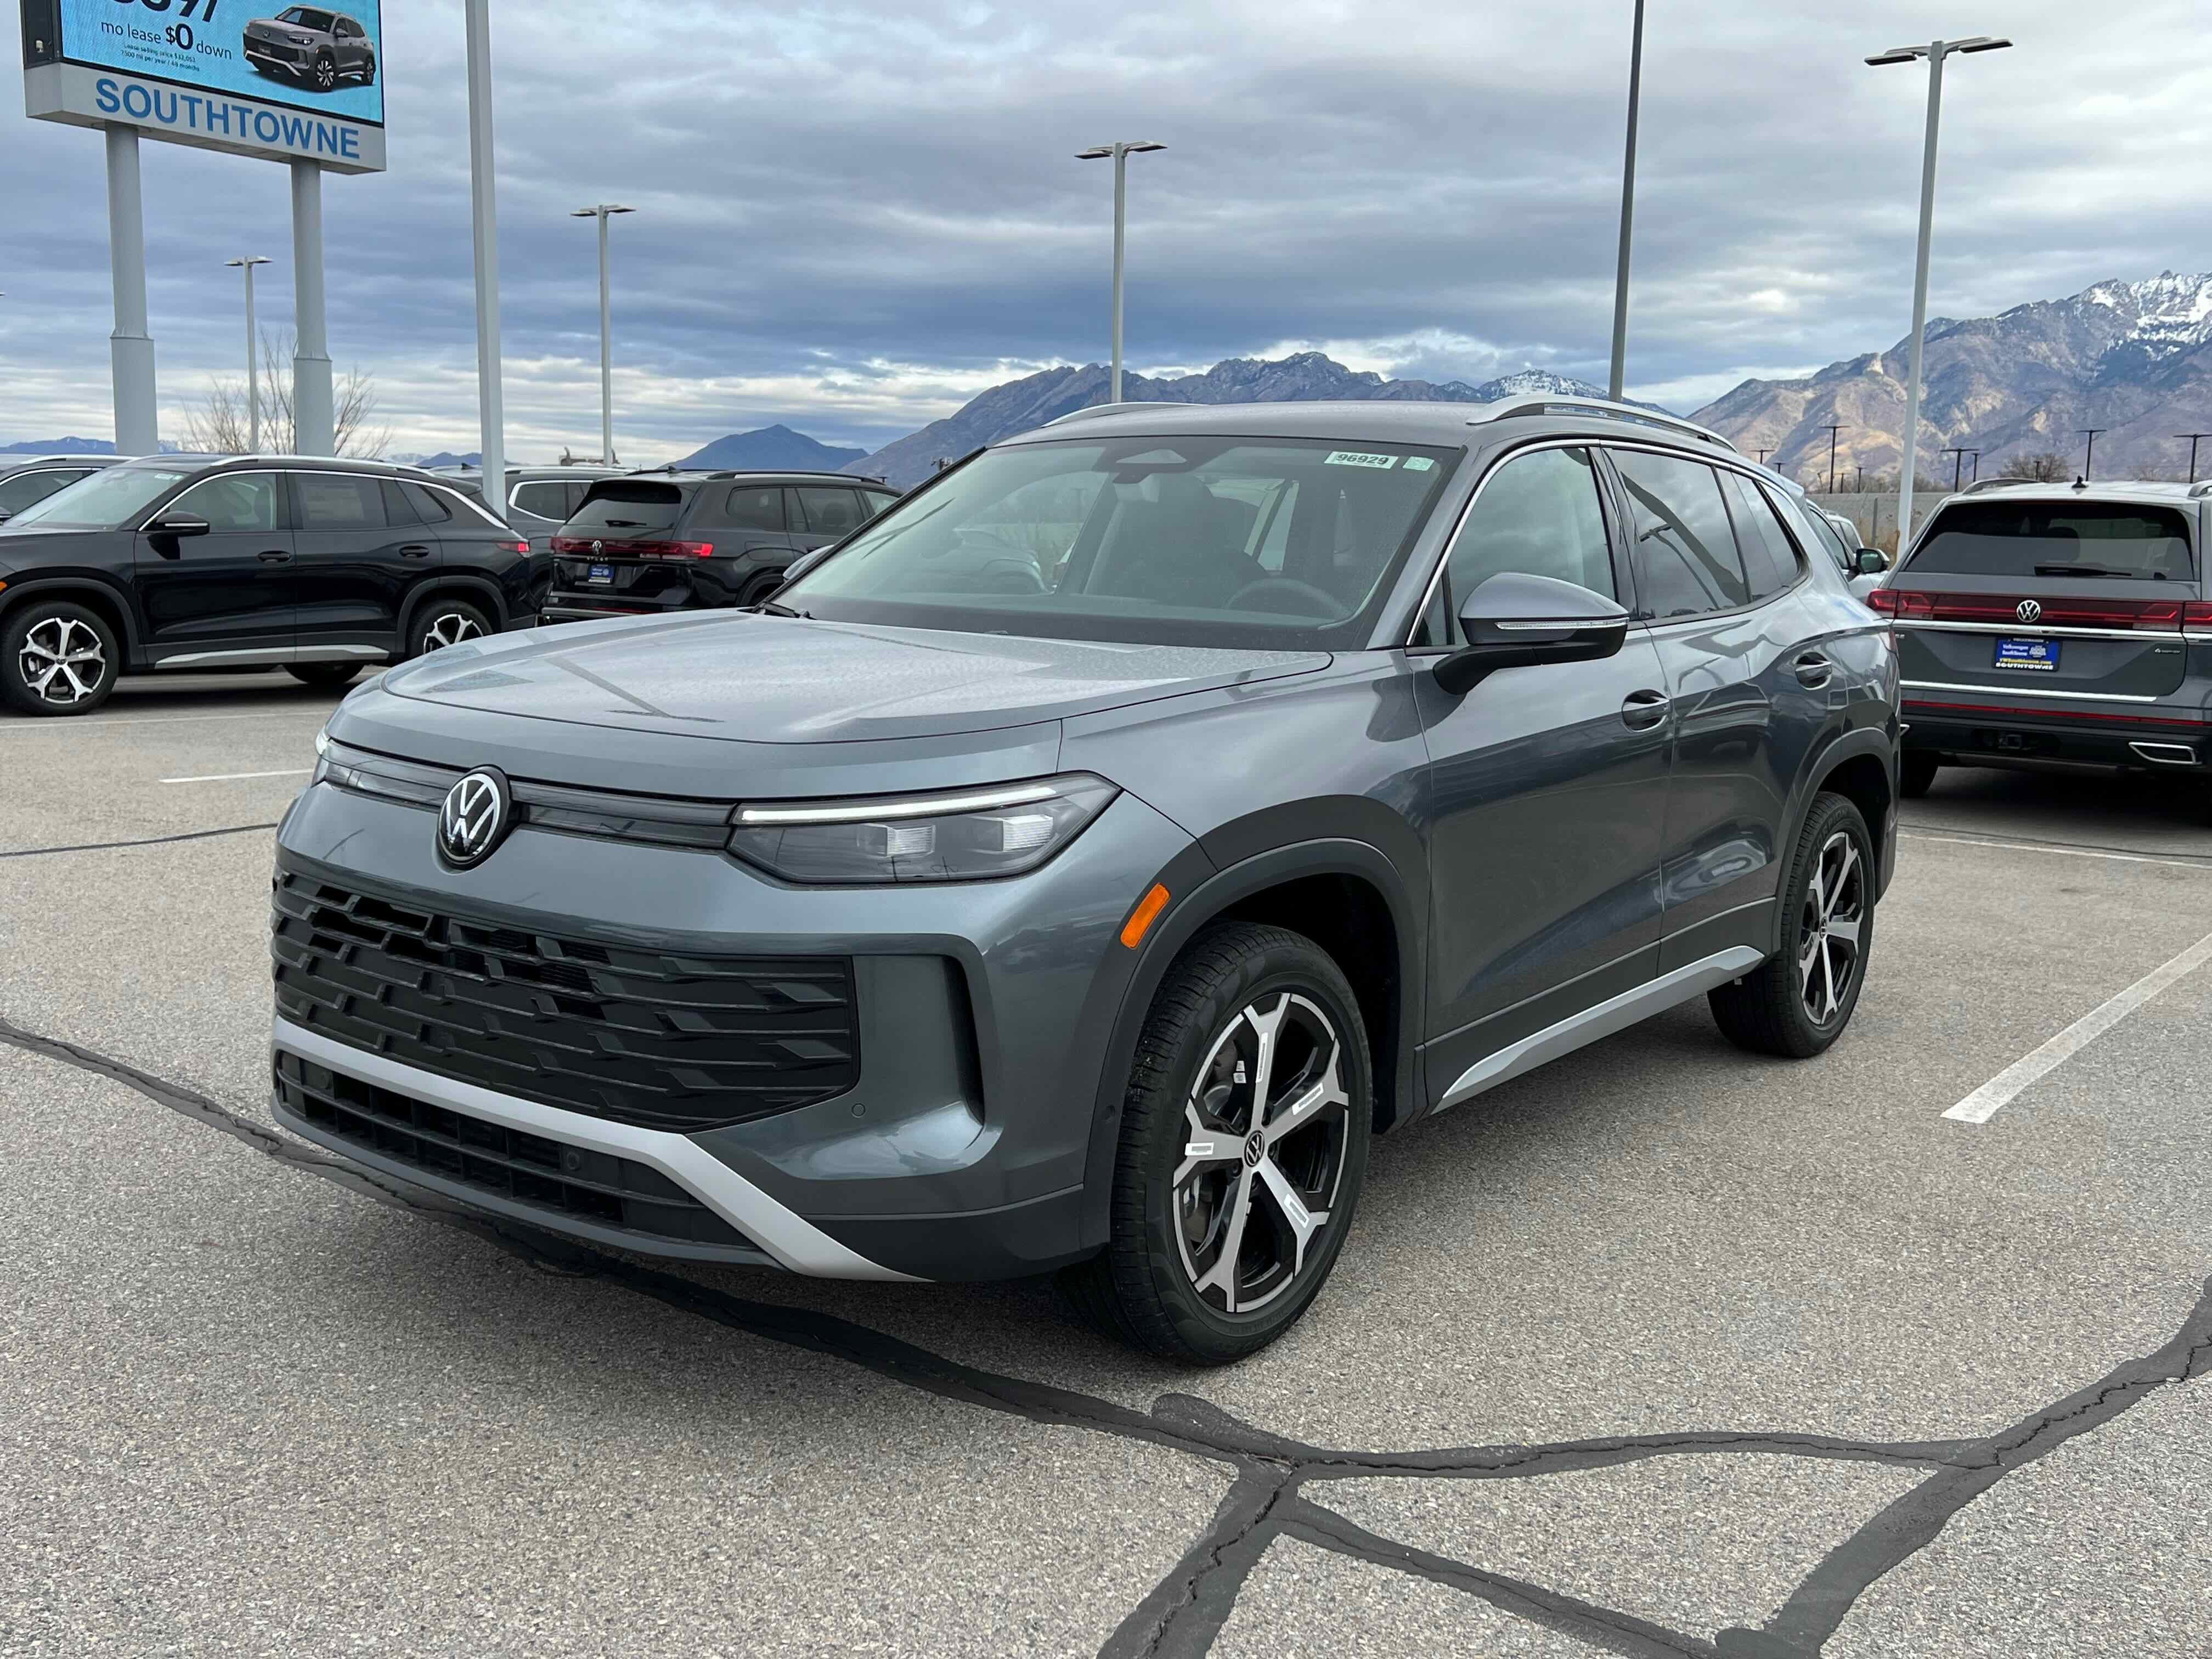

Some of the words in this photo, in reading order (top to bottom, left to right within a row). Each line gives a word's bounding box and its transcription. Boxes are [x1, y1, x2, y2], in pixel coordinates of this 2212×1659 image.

[101, 21, 123, 35] mo
[128, 24, 161, 43] lease
[166, 23, 193, 50] $0
[196, 40, 232, 59] down
[95, 78, 360, 159] SOUTHTOWNE
[1336, 454, 1389, 465] 96929
